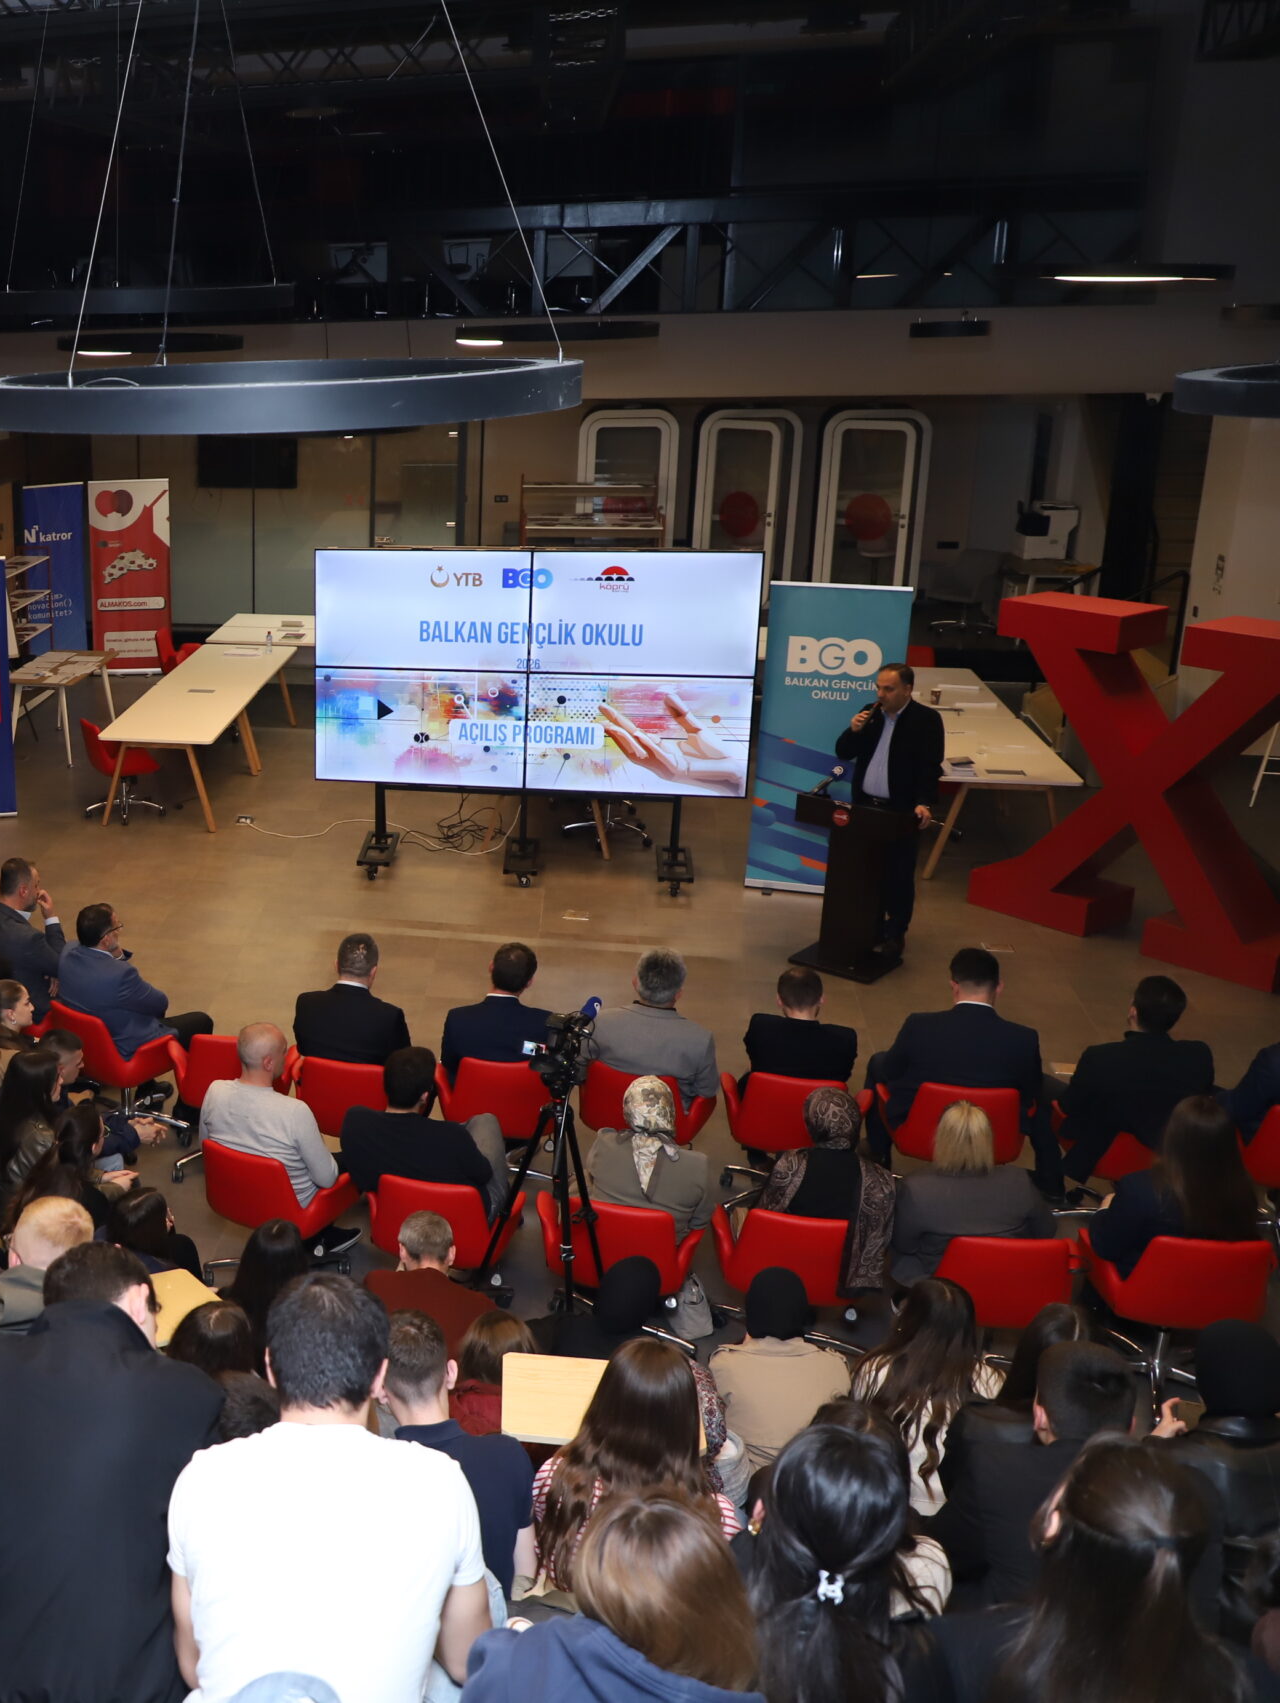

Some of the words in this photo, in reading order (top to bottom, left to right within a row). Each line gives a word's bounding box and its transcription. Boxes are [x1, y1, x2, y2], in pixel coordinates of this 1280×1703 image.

[39, 530, 73, 543] katror
[453, 571, 483, 588] YTB
[502, 567, 553, 589] BGO
[599, 582, 630, 592] köprü
[418, 619, 493, 643] BALKAN
[497, 619, 576, 649] GENÇLİK
[581, 622, 644, 647] OKULU
[516, 657, 541, 670] 2026
[785, 635, 883, 678] BGO
[784, 676, 829, 688] BALKAN
[811, 690, 850, 701] OKULU
[458, 720, 508, 748] AÇILIŞ
[512, 722, 596, 746] PROGRAMI
